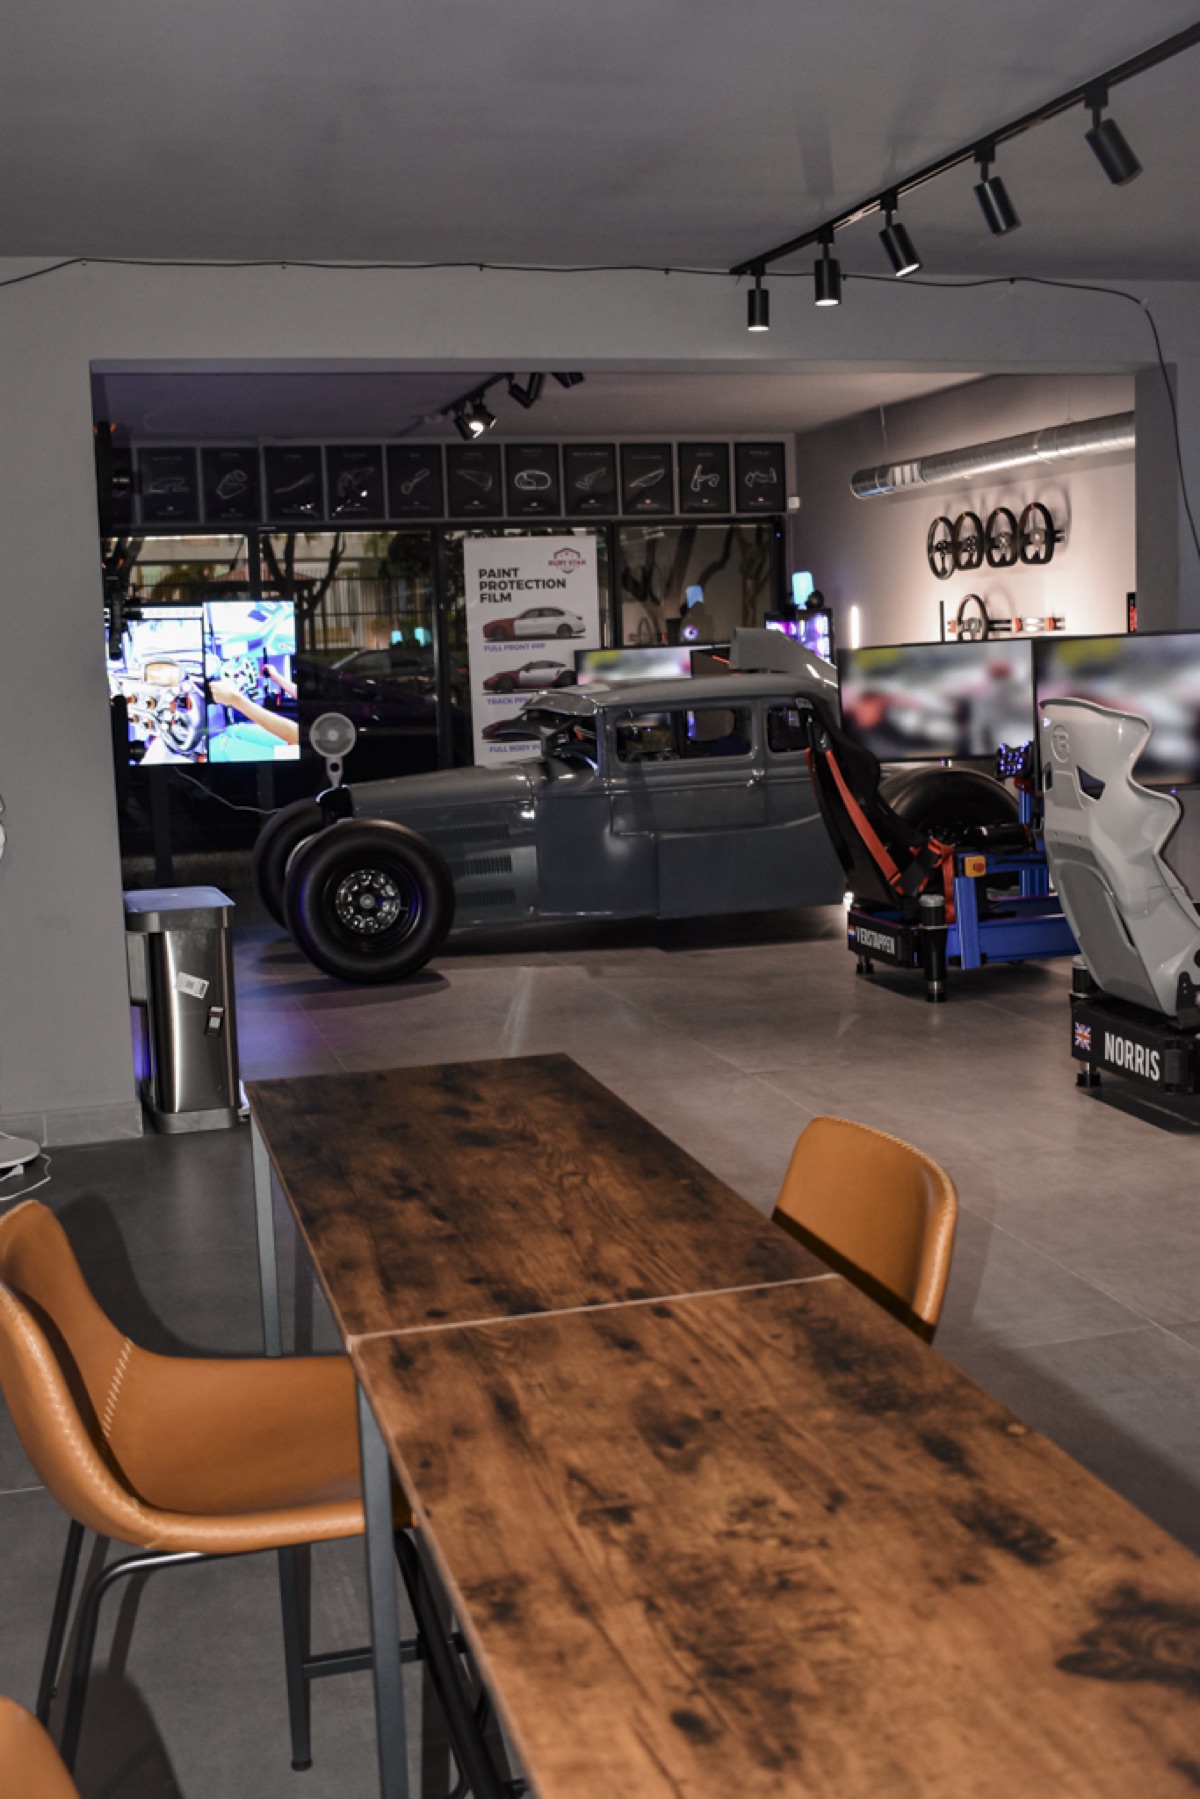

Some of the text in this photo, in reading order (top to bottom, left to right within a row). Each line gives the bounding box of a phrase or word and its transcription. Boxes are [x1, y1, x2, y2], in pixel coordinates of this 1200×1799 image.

[478, 567, 520, 579] PAINT
[479, 578, 567, 590] PROTECTION
[480, 592, 512, 603] FILM
[509, 744, 531, 752] BODY
[1104, 1031, 1160, 1081] NORRIS
